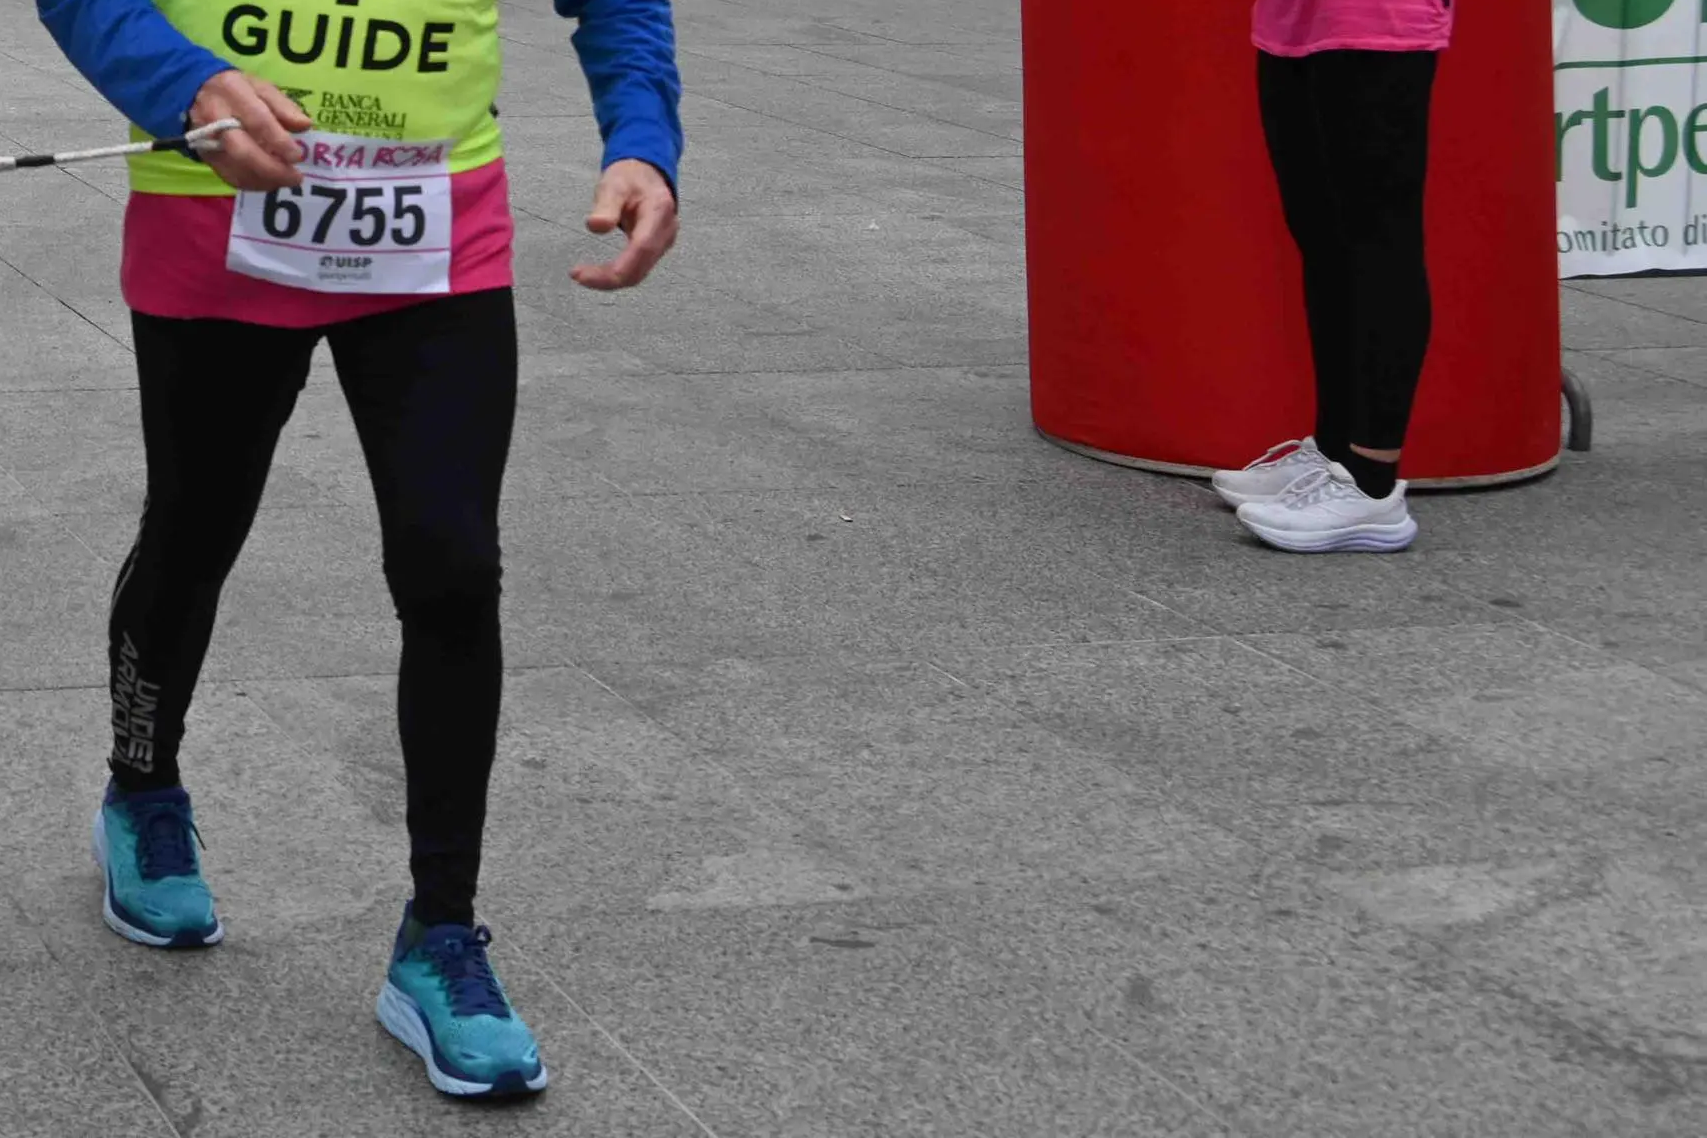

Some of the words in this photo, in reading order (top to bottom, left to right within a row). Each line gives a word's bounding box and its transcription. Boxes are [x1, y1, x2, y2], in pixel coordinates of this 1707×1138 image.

[222, 4, 456, 73] GUIDE
[321, 91, 383, 111] BANCA
[316, 111, 407, 128] GENERALI
[263, 185, 426, 246] 6755
[336, 256, 374, 268] UISP
